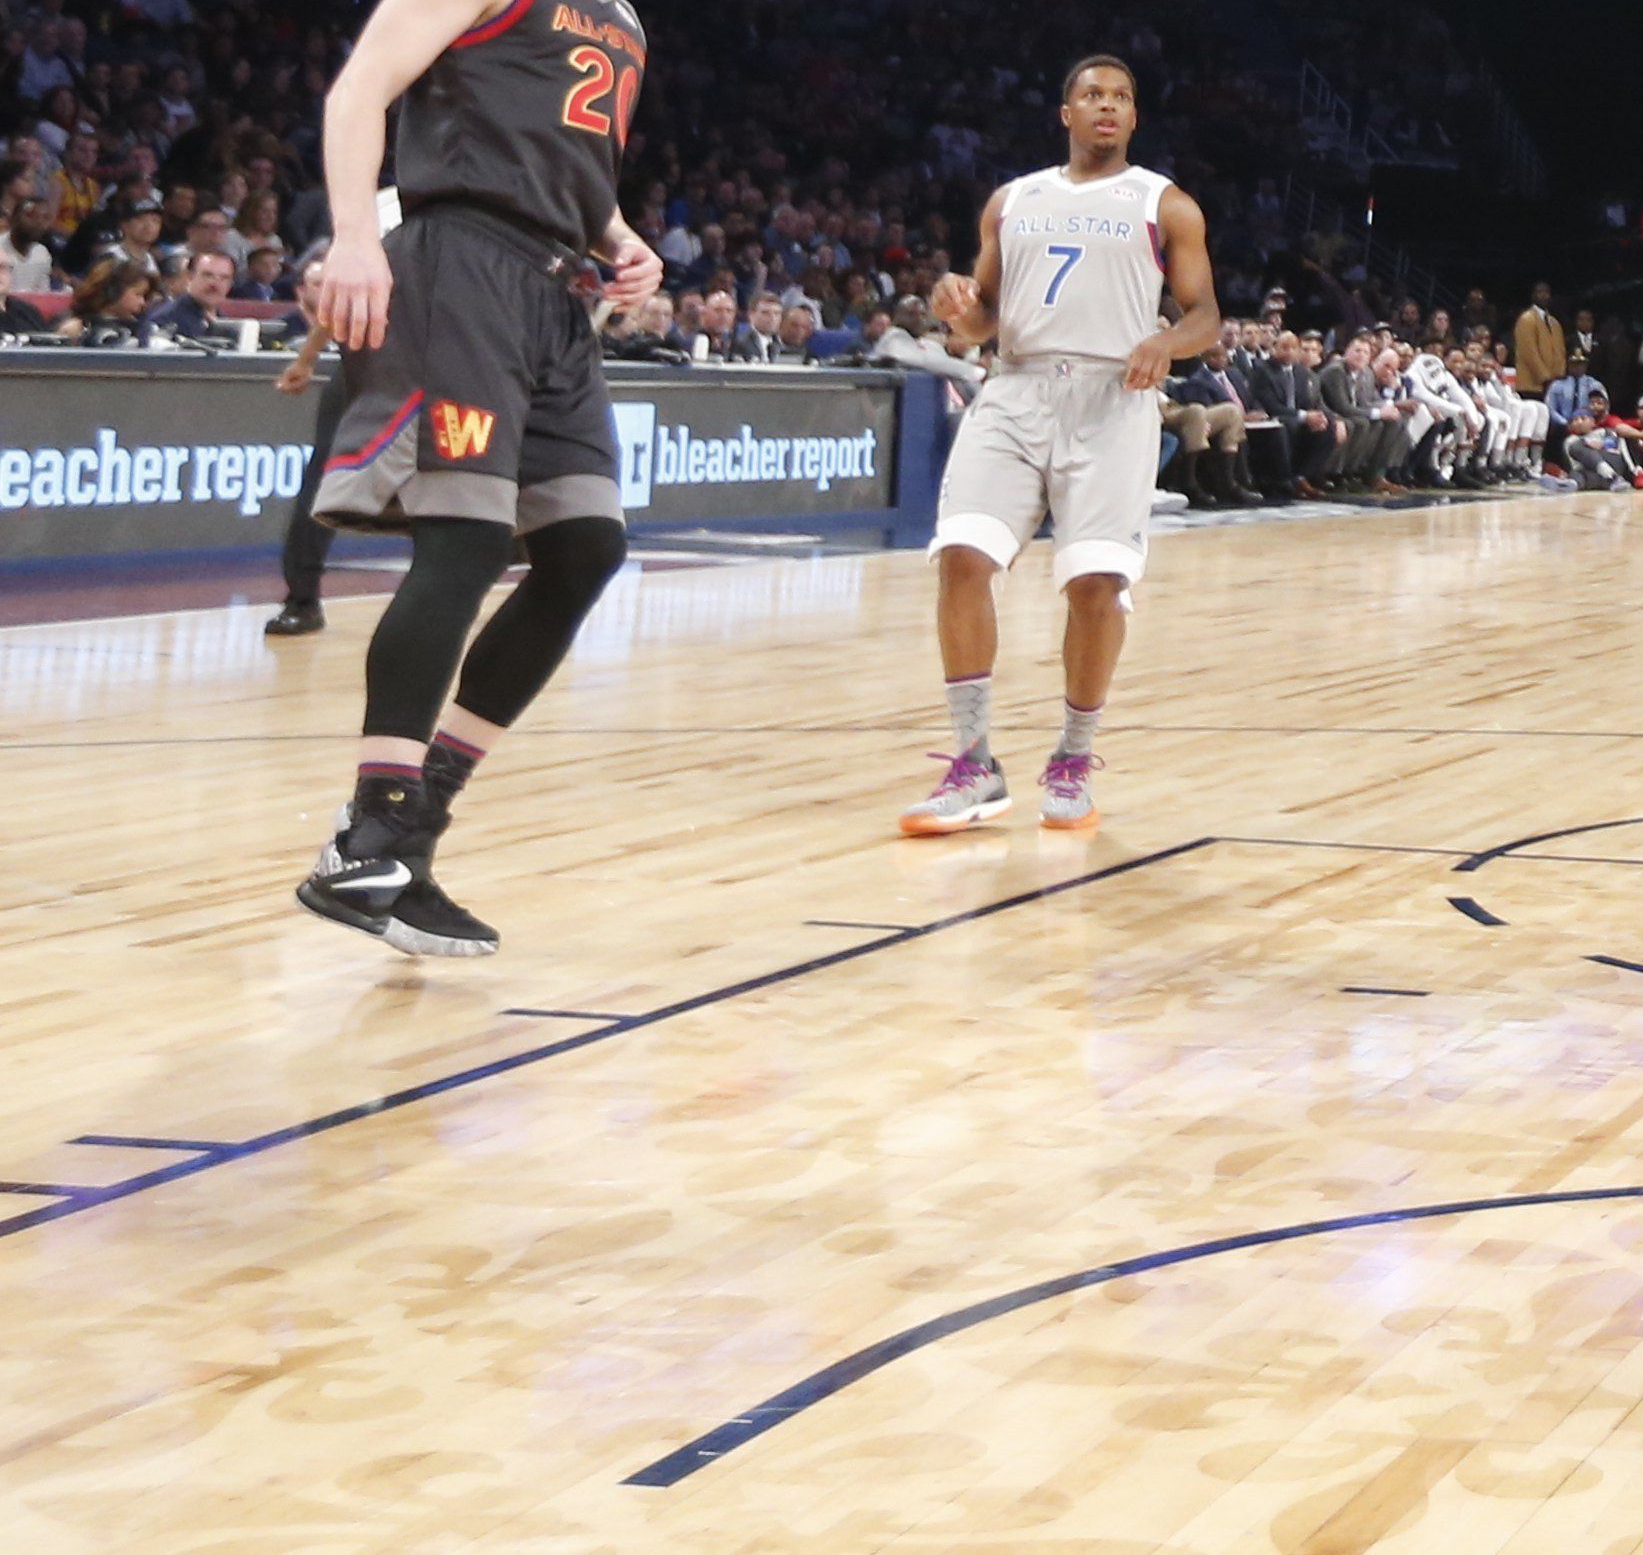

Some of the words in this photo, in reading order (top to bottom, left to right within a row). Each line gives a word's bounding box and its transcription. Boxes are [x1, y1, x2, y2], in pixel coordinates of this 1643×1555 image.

[1043, 244, 1085, 308] 7
[655, 424, 790, 485] bleacher
[791, 428, 876, 491] report
